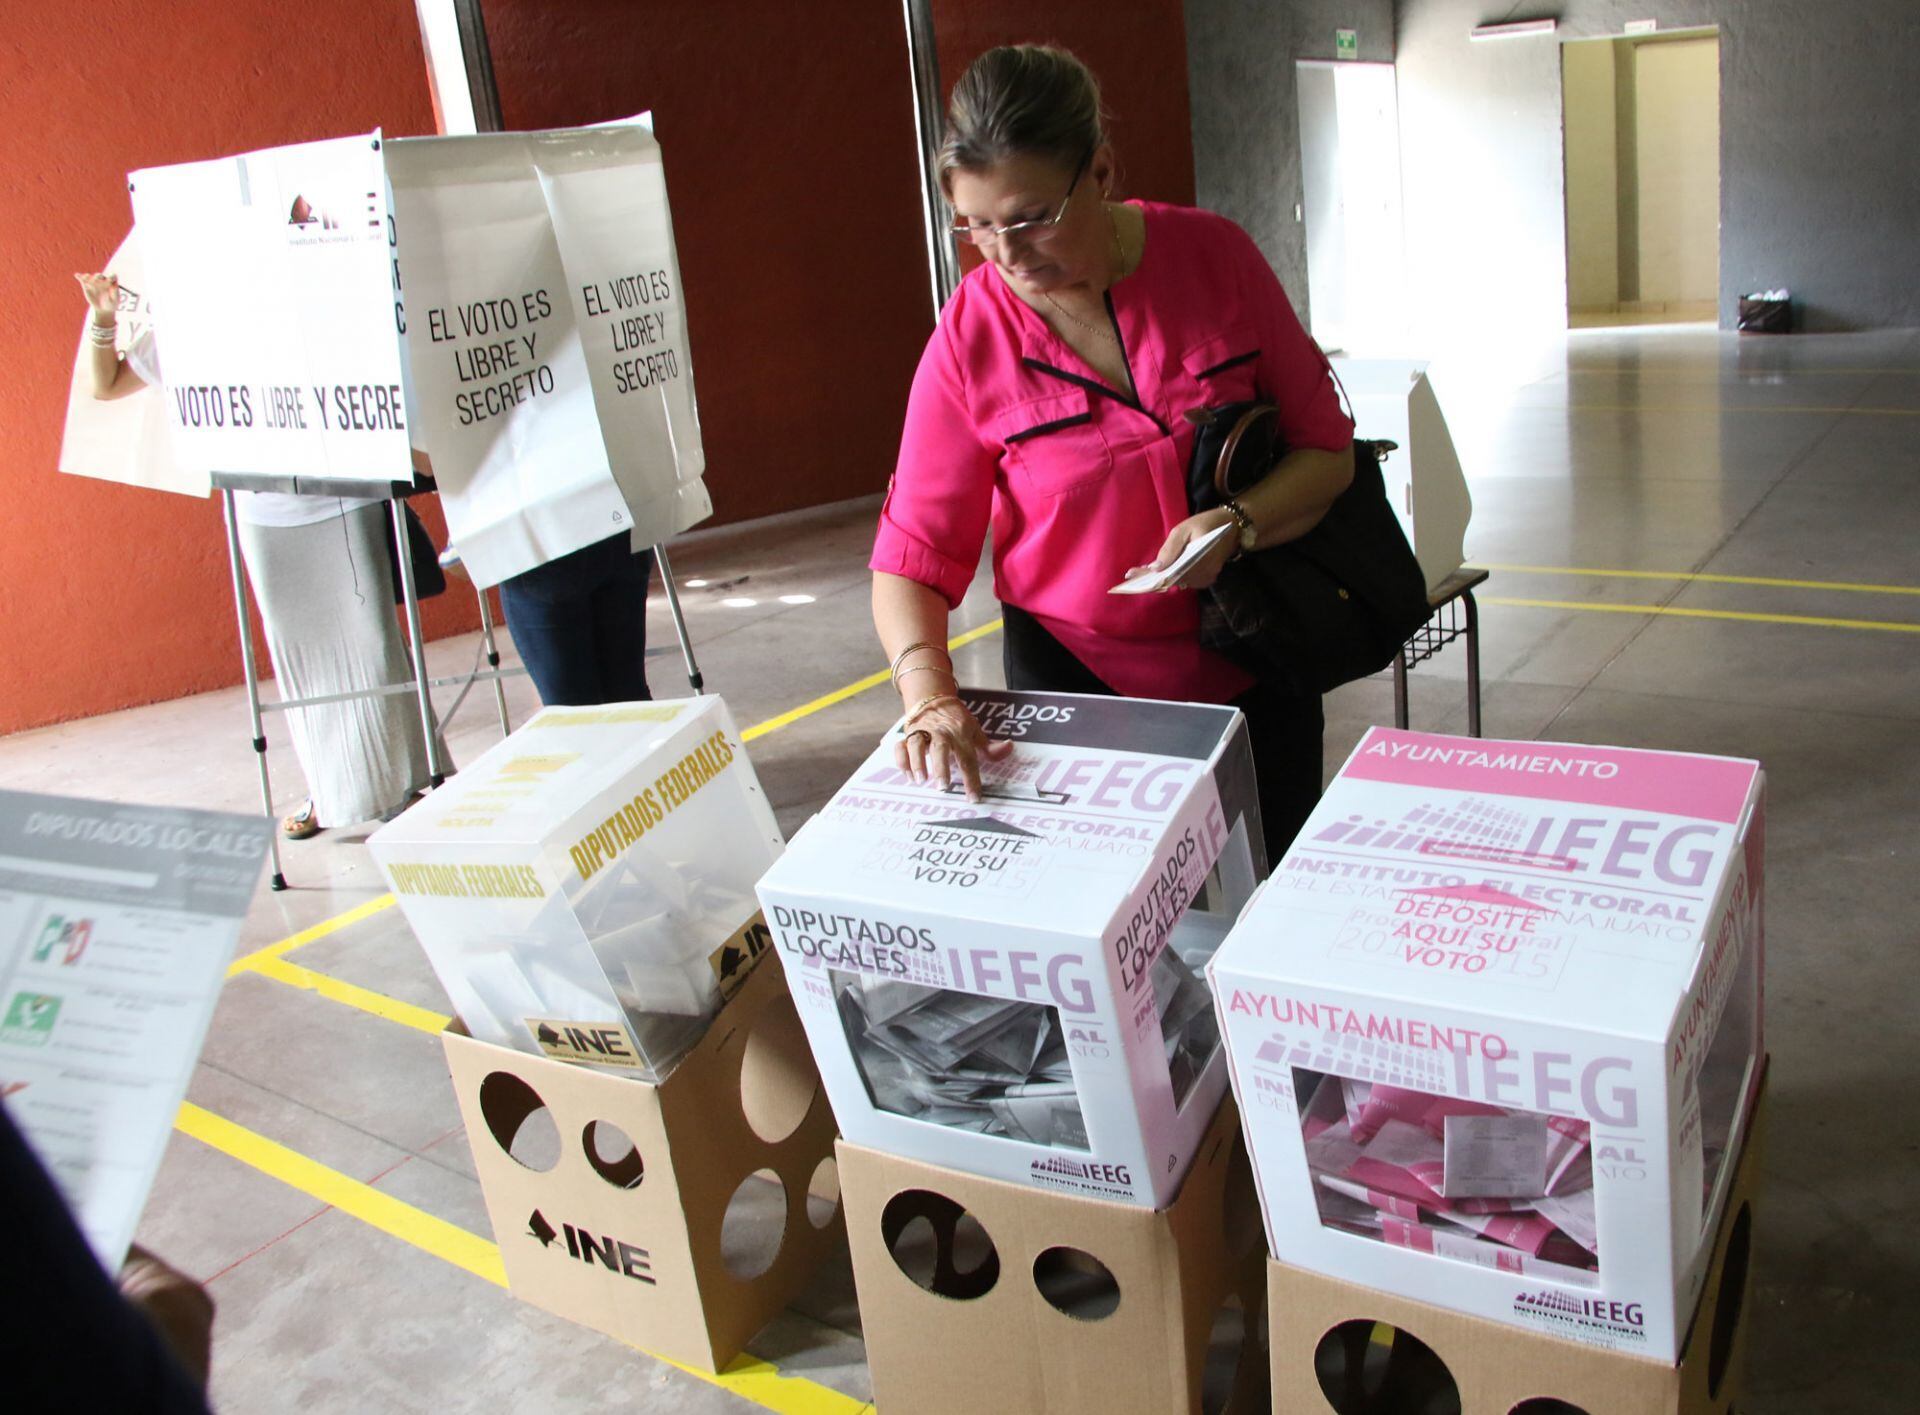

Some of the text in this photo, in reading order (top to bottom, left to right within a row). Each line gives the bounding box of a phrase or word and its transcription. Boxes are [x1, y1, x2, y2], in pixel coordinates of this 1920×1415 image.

[428, 308, 456, 342] EL
[458, 298, 518, 337] VOTO
[522, 289, 552, 322] ES
[583, 270, 670, 316] EL VOTO ES
[611, 312, 664, 352] LIBRE Y
[455, 332, 537, 382] LIBRE Y
[613, 349, 679, 394] SECRETO
[175, 386, 224, 427] VOTO
[230, 385, 253, 427] ES
[261, 386, 307, 429] LIBRE
[313, 386, 329, 430] Y
[456, 364, 554, 425] SECRETO
[1366, 740, 1619, 779] AYUNTAMIENTO
[569, 730, 734, 881] DIPUTADOS FEDERALES
[836, 795, 979, 819] INSTITUTO
[1035, 759, 1194, 813] IEEG
[24, 811, 155, 848] DIPUTADOS
[158, 827, 265, 858] LOCALES
[914, 829, 1029, 855] DEPOSITE
[1521, 816, 1721, 886] IEEG
[387, 863, 545, 898] DIPUTADOS FEDERALES
[908, 848, 974, 867] AQUÍ
[974, 855, 1008, 871] SU
[915, 866, 979, 887] VOTO
[1115, 827, 1196, 966] DIPUTADOS
[1286, 856, 1697, 923] INSTITUTO ELECTORAL
[773, 905, 936, 952] DIPUTADOS
[1122, 877, 1188, 992] LOCALES
[1392, 921, 1474, 946] AQUÍ
[1476, 932, 1518, 953] SU
[1395, 898, 1541, 933] DEPOSITE
[781, 930, 907, 974] LOCALES
[1406, 944, 1487, 973] VOTO
[1673, 872, 1745, 1074] AYUNTAMIENTO
[563, 1027, 631, 1056] INE
[1230, 989, 1509, 1061] AYUNTAMIENTO
[1453, 1045, 1638, 1128] IEEG
[1082, 1164, 1132, 1185] IEEG
[562, 1222, 657, 1286] INE
[1578, 1319, 1645, 1337] ELECTORAL
[1583, 1299, 1644, 1326] IEEG
